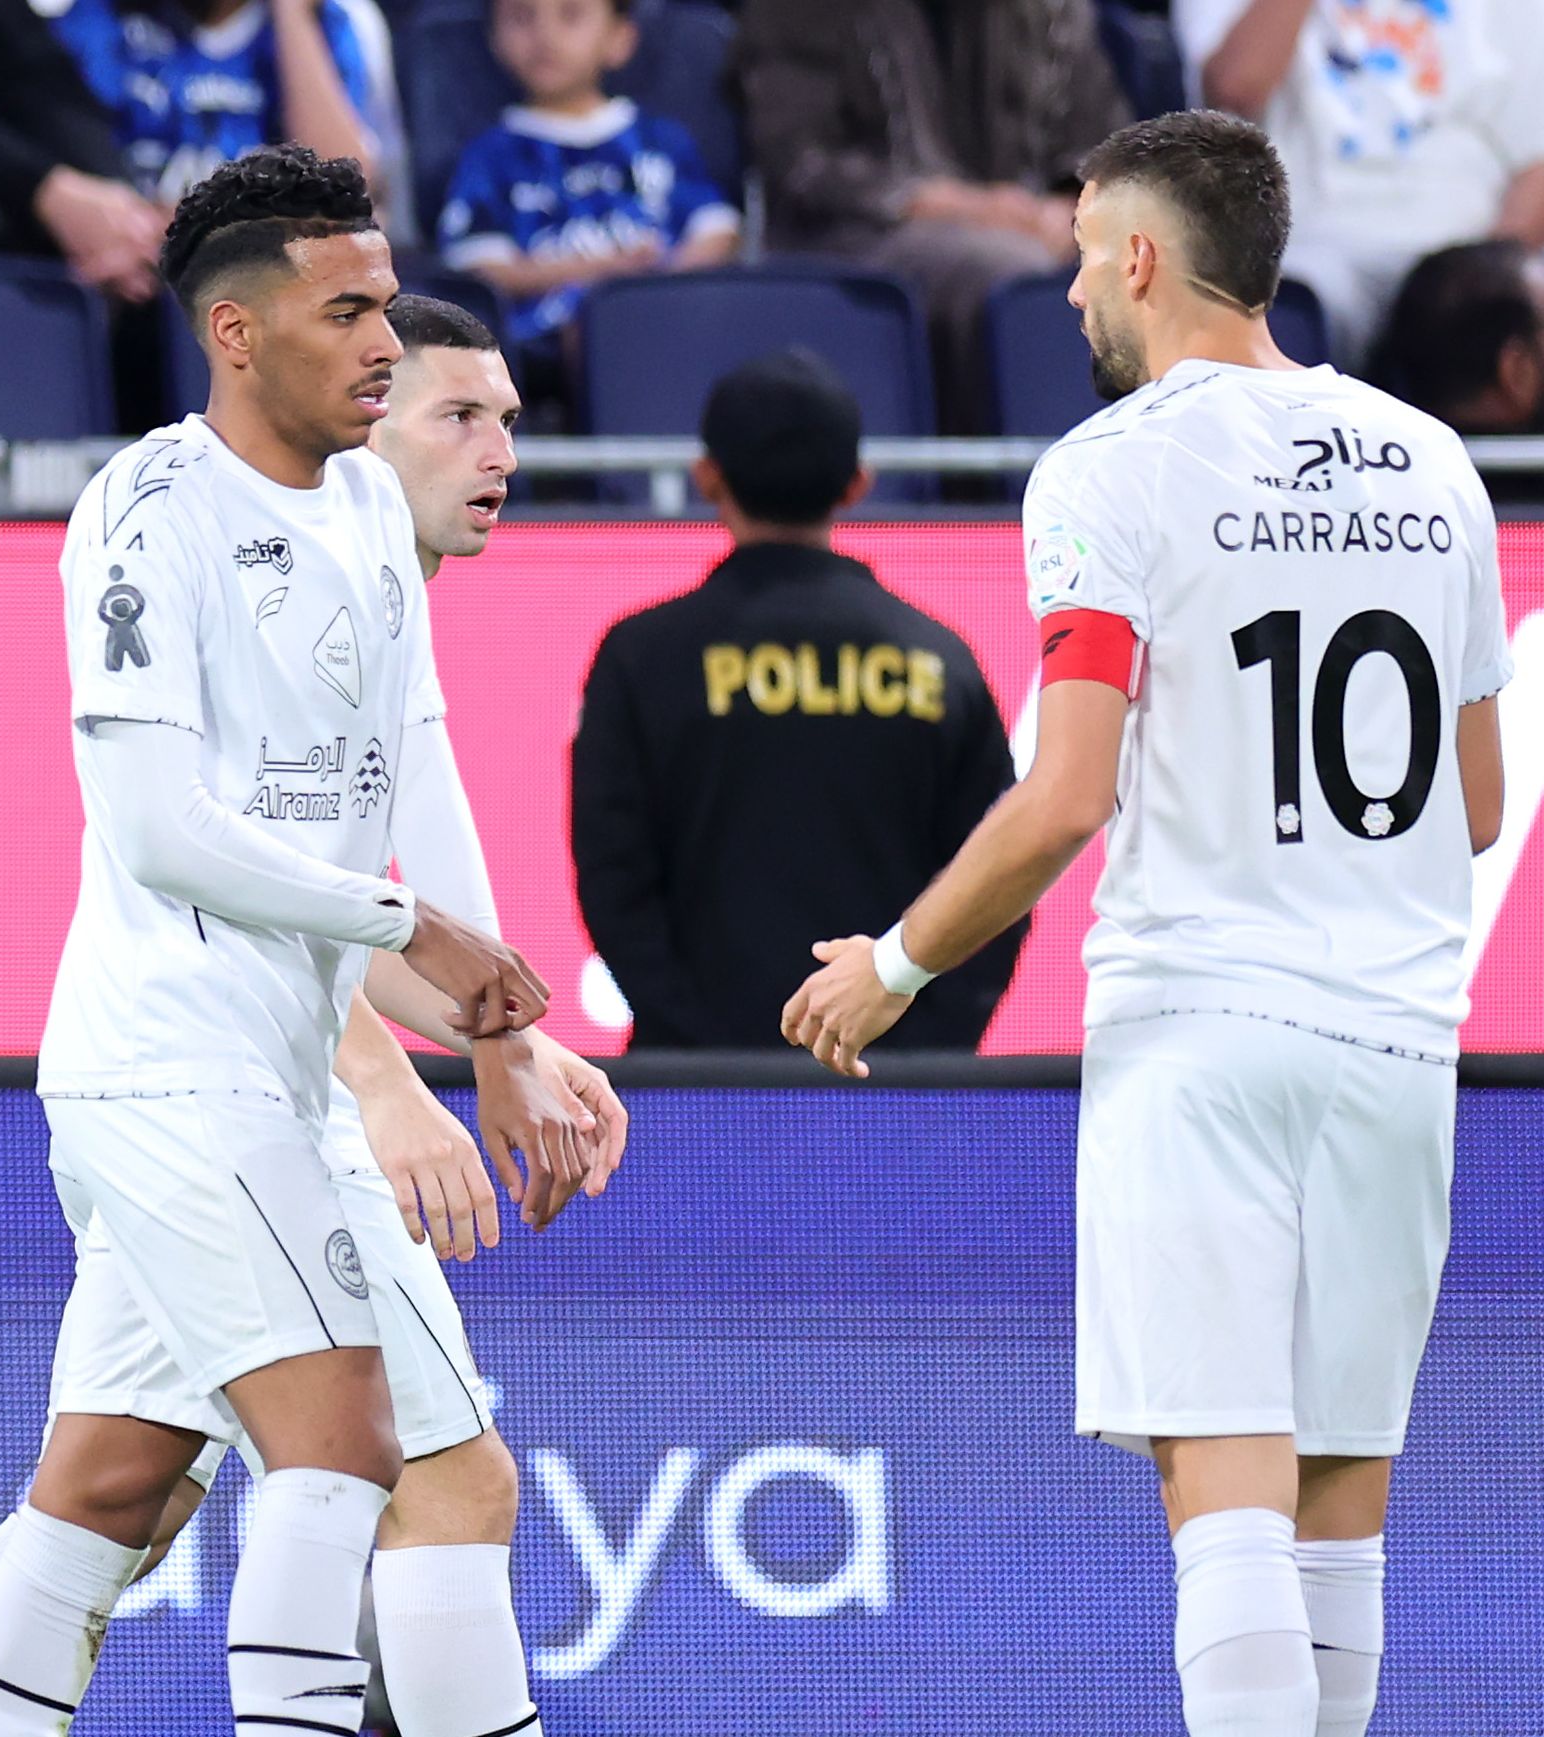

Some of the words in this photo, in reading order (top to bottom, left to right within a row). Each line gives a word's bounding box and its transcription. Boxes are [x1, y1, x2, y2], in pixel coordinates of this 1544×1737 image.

[1292, 427, 1411, 478] مزاج
[1213, 511, 1452, 554] CARRASCO
[702, 643, 946, 722] POLICE
[1230, 609, 1441, 845] 10
[256, 736, 346, 782] الرمز
[243, 783, 340, 821] Alramz
